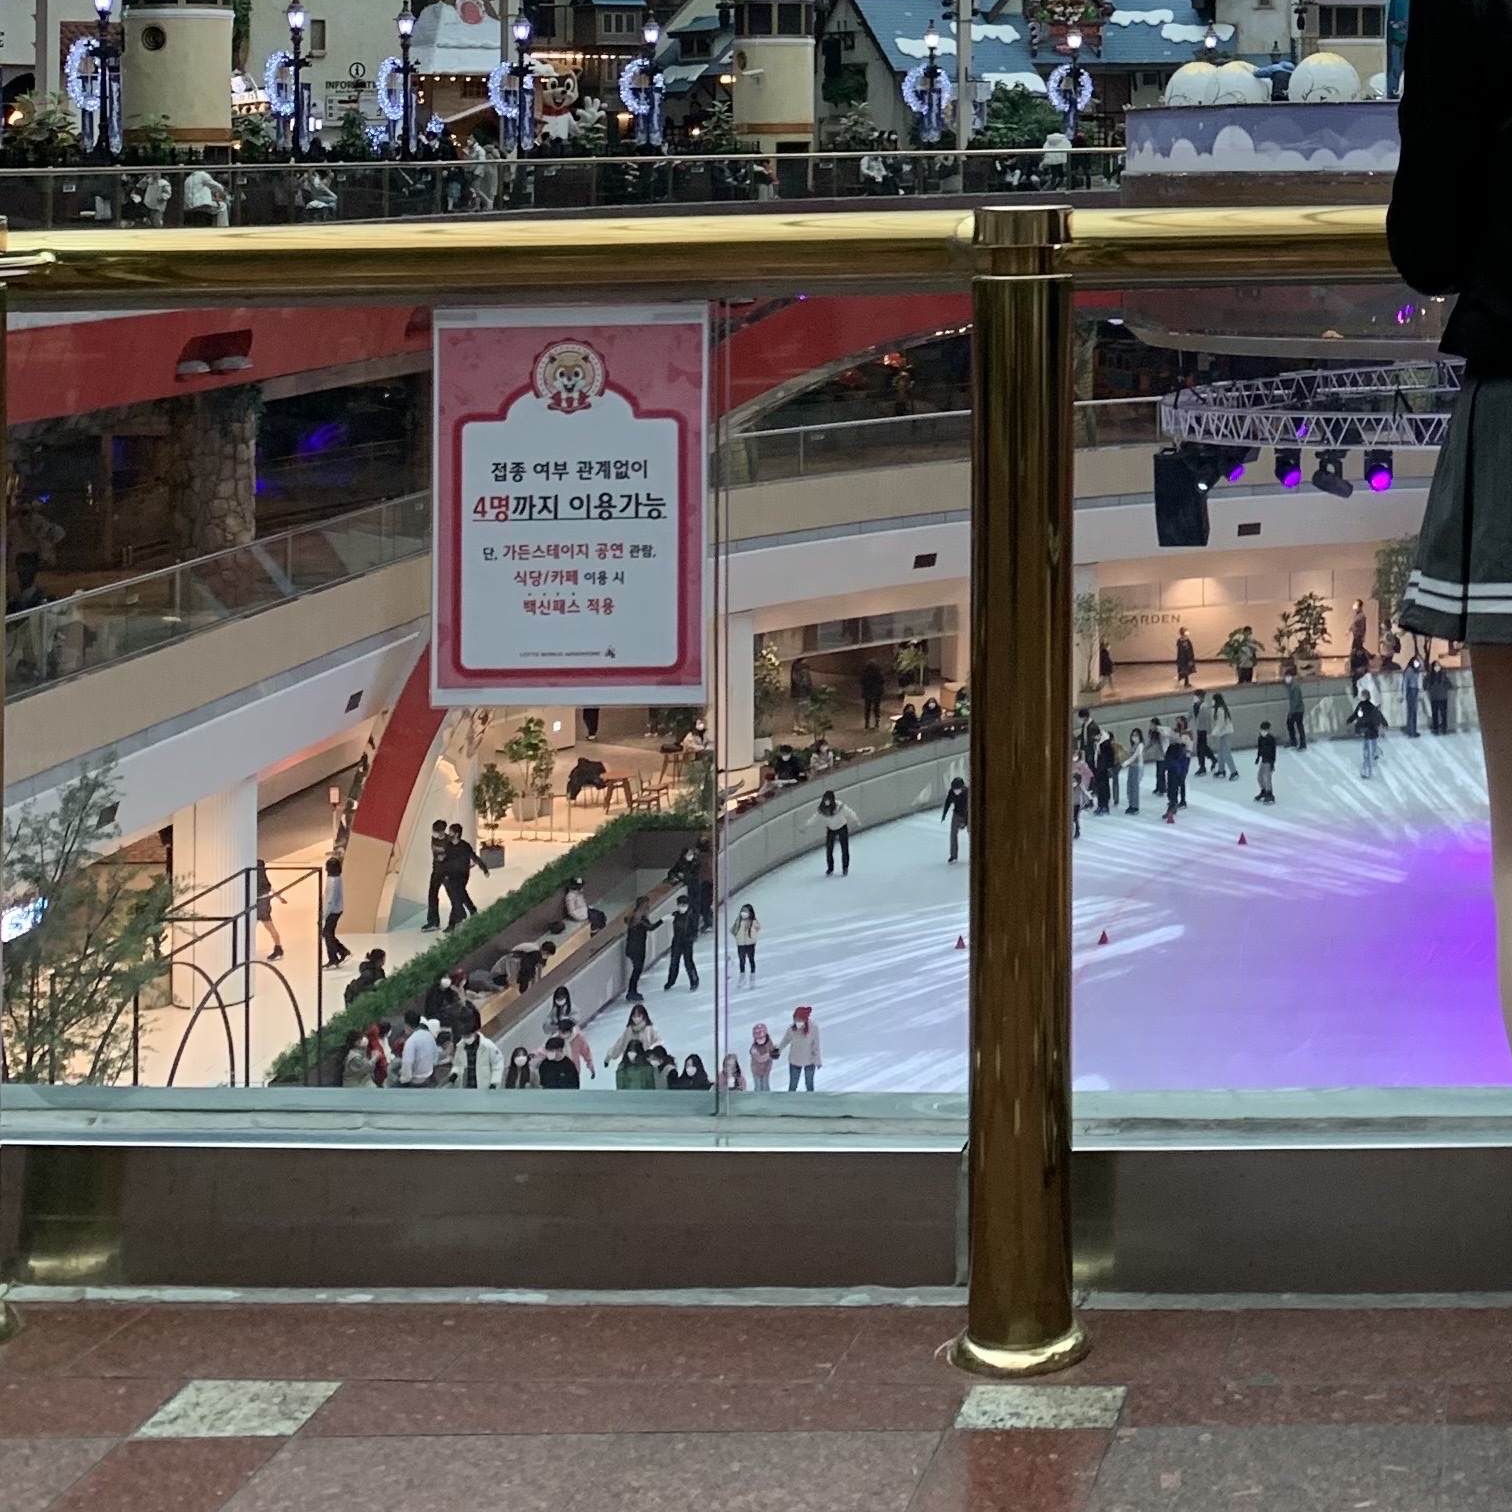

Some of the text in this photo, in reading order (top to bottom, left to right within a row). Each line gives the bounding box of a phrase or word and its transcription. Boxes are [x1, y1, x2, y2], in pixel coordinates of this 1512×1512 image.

[491, 459, 648, 483] 접종 여부 관계없이
[473, 491, 667, 522] 4명까지 이용가능
[503, 544, 590, 561] 가든스테이지
[595, 542, 624, 560] 공연
[629, 544, 656, 559] 관람,
[514, 569, 624, 587] 식당/카페 이용 시
[523, 597, 615, 616] 백신패스 적용
[1119, 614, 1180, 625] GARDEN
